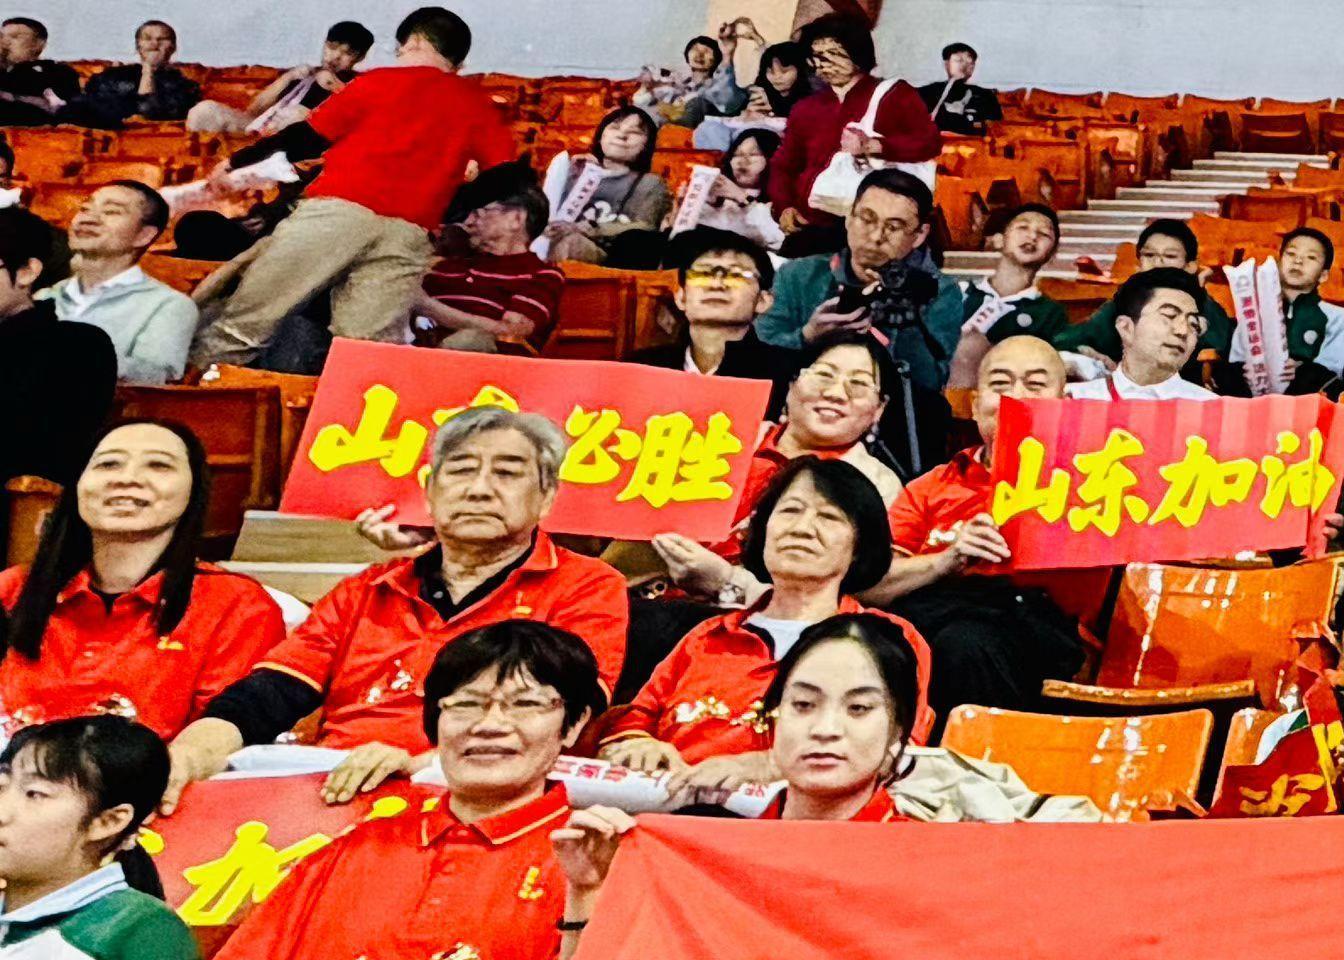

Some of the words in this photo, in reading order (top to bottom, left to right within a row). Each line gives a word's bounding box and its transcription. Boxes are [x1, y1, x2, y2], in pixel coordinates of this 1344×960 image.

[308, 384, 743, 510] 山必胜
[990, 429, 1337, 538] 山东加油
